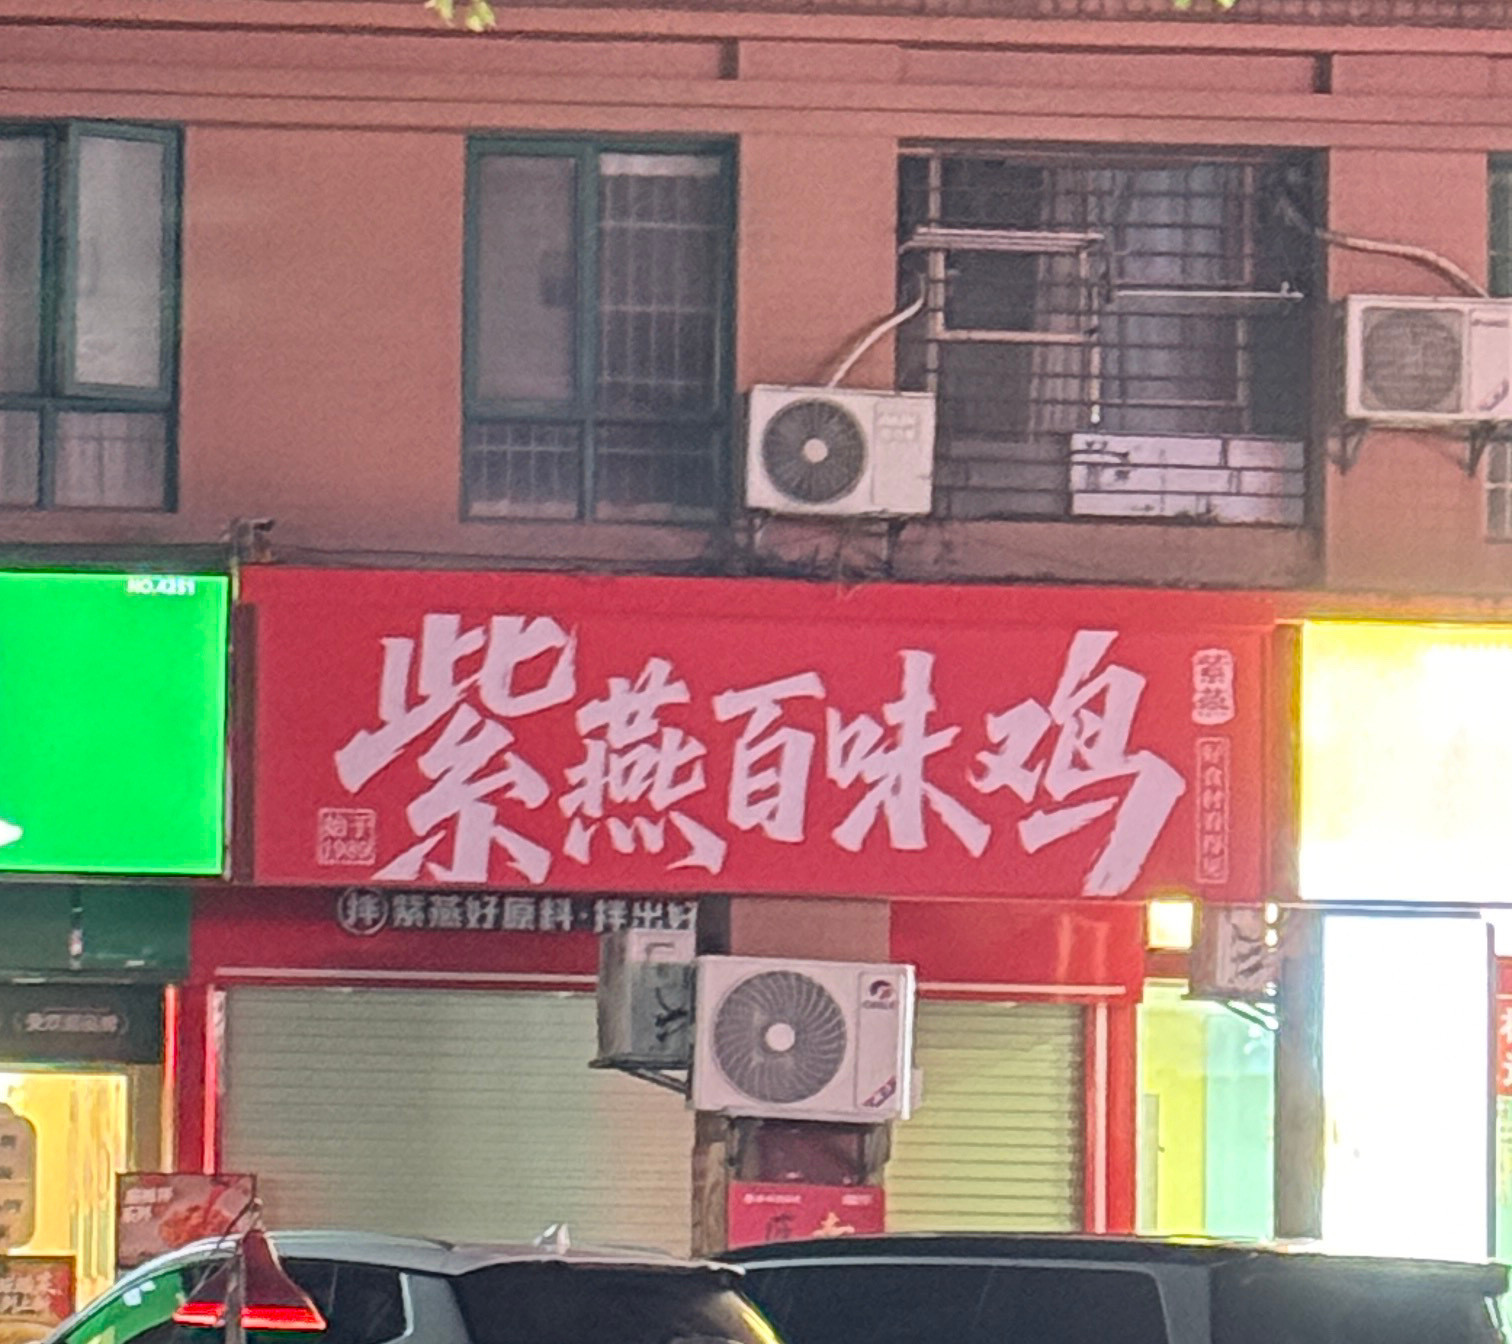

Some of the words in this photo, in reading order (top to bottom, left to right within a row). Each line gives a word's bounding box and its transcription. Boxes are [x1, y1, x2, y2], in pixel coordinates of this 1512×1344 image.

[334, 613, 1186, 897] 紫燕百味鸡
